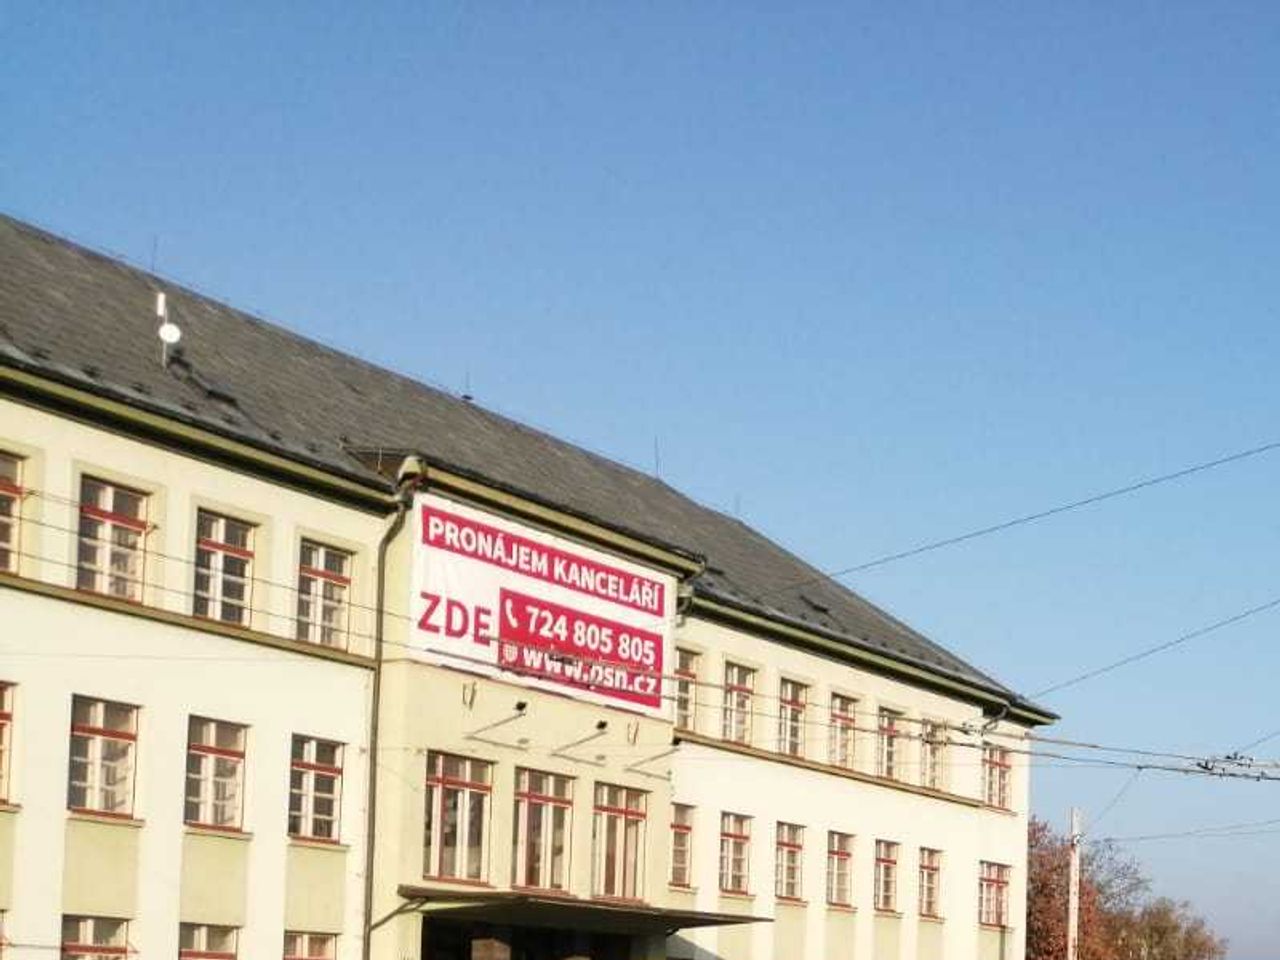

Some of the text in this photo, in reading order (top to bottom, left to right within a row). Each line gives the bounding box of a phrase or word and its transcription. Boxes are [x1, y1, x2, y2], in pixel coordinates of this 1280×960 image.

[428, 515, 660, 610] PRONÁJEM KANCELÁŘÍ
[417, 591, 492, 646] ZDE
[525, 605, 655, 665] 724 805 805
